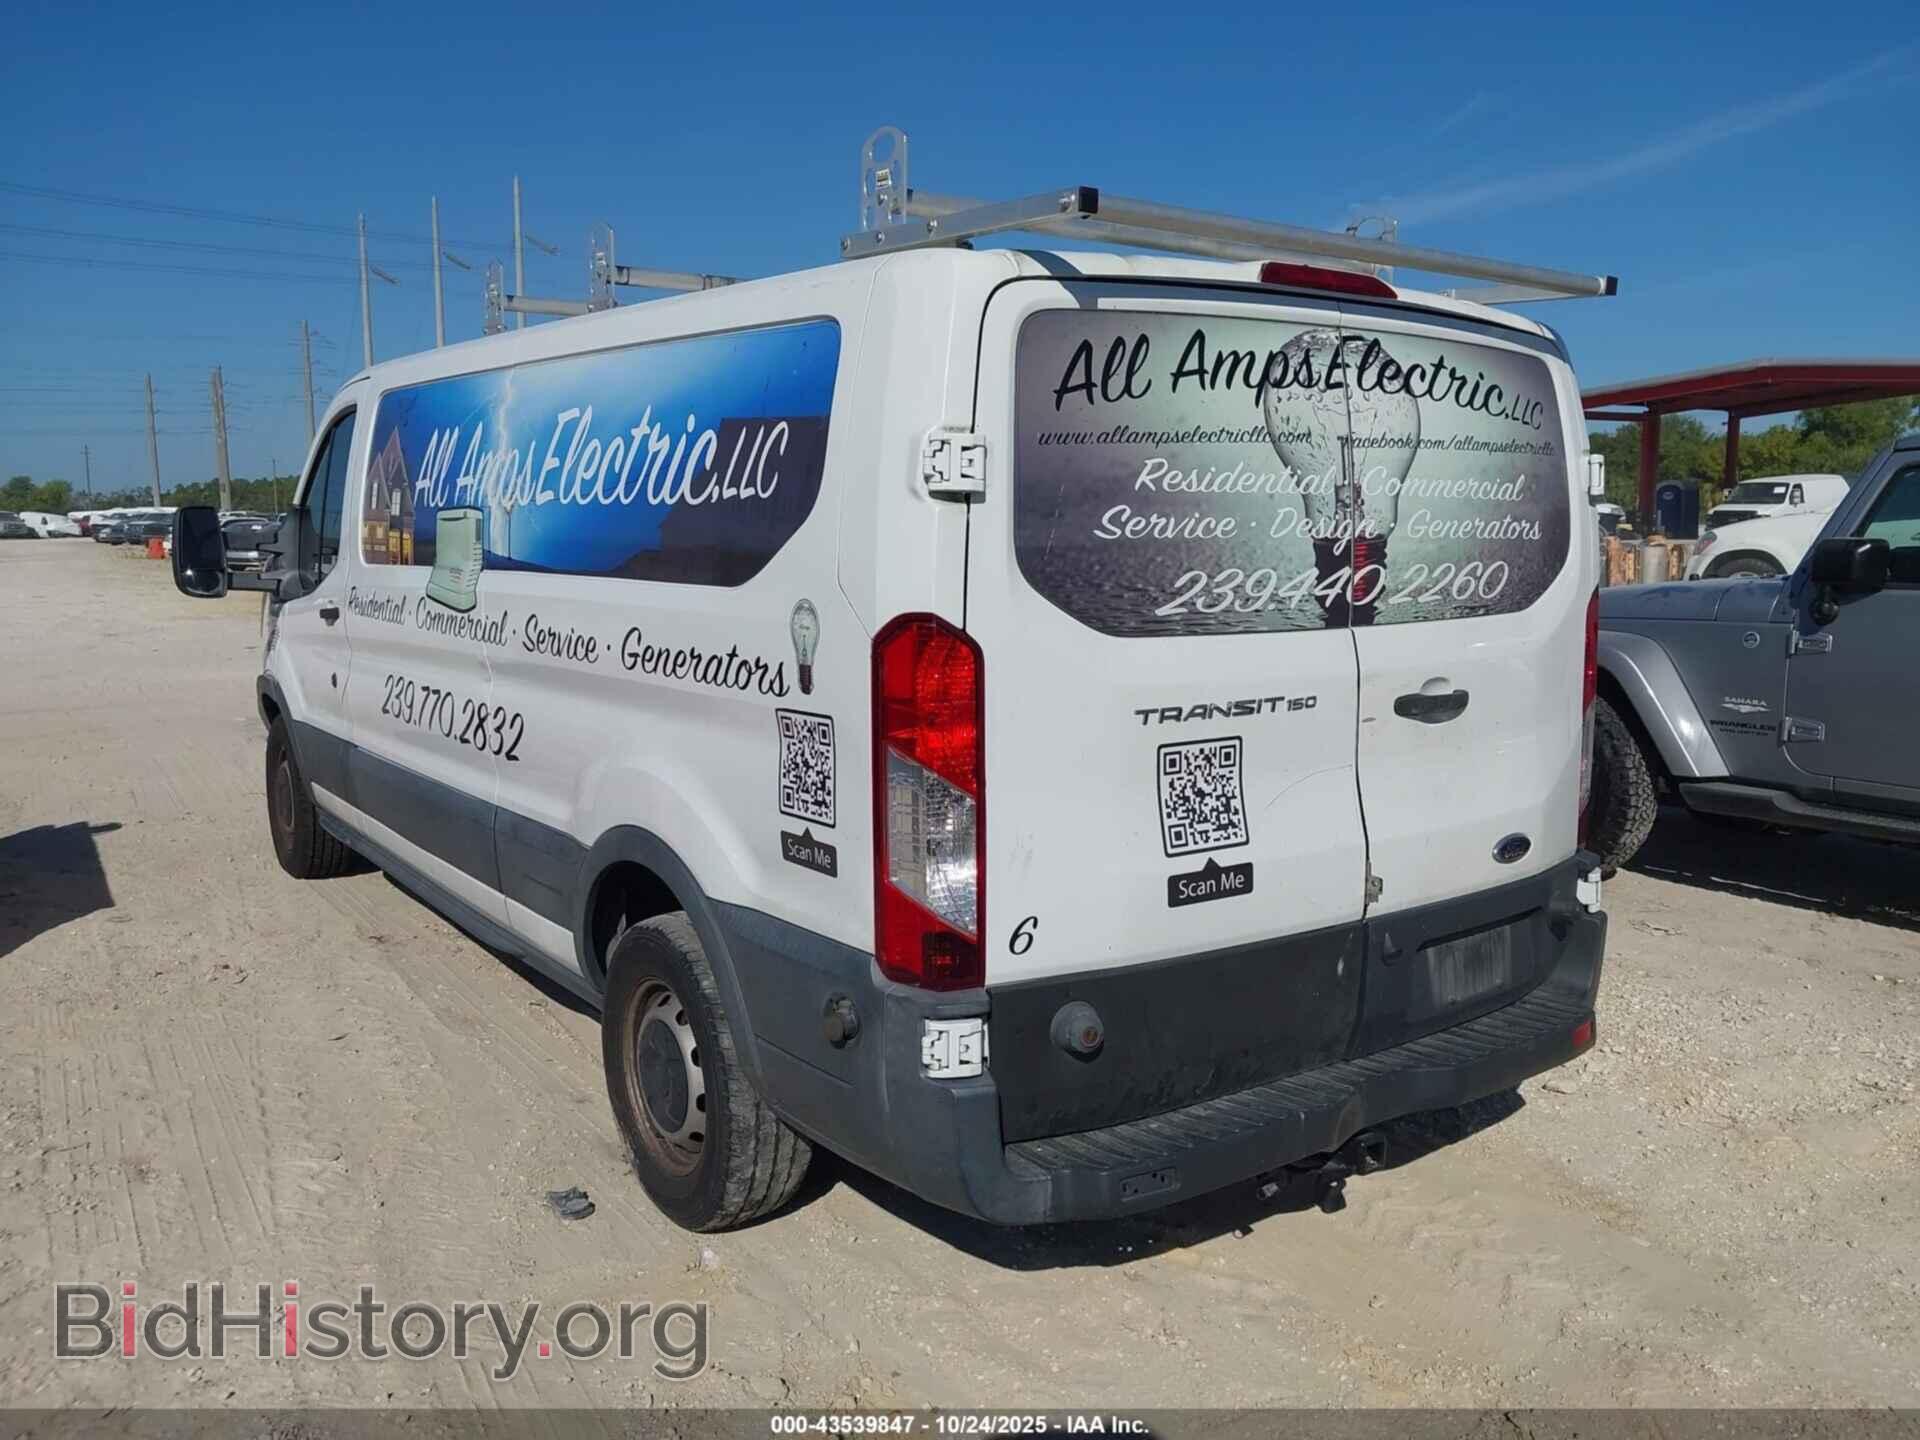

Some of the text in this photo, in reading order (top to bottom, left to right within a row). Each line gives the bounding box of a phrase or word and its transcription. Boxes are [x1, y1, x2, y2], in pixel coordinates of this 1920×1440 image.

[1053, 332, 1151, 411] All
[414, 426, 459, 507] All
[1134, 458, 1525, 502] Residential Commercial
[1093, 504, 1543, 555] Service Design Generators
[348, 586, 790, 697] Residential Commercial Service Generators
[382, 674, 525, 761] 239.770.2832
[1134, 696, 1286, 726] TRANSIT
[787, 838, 831, 869] Scan Me
[1178, 871, 1245, 899] Scan Me
[1008, 916, 1038, 955] 6
